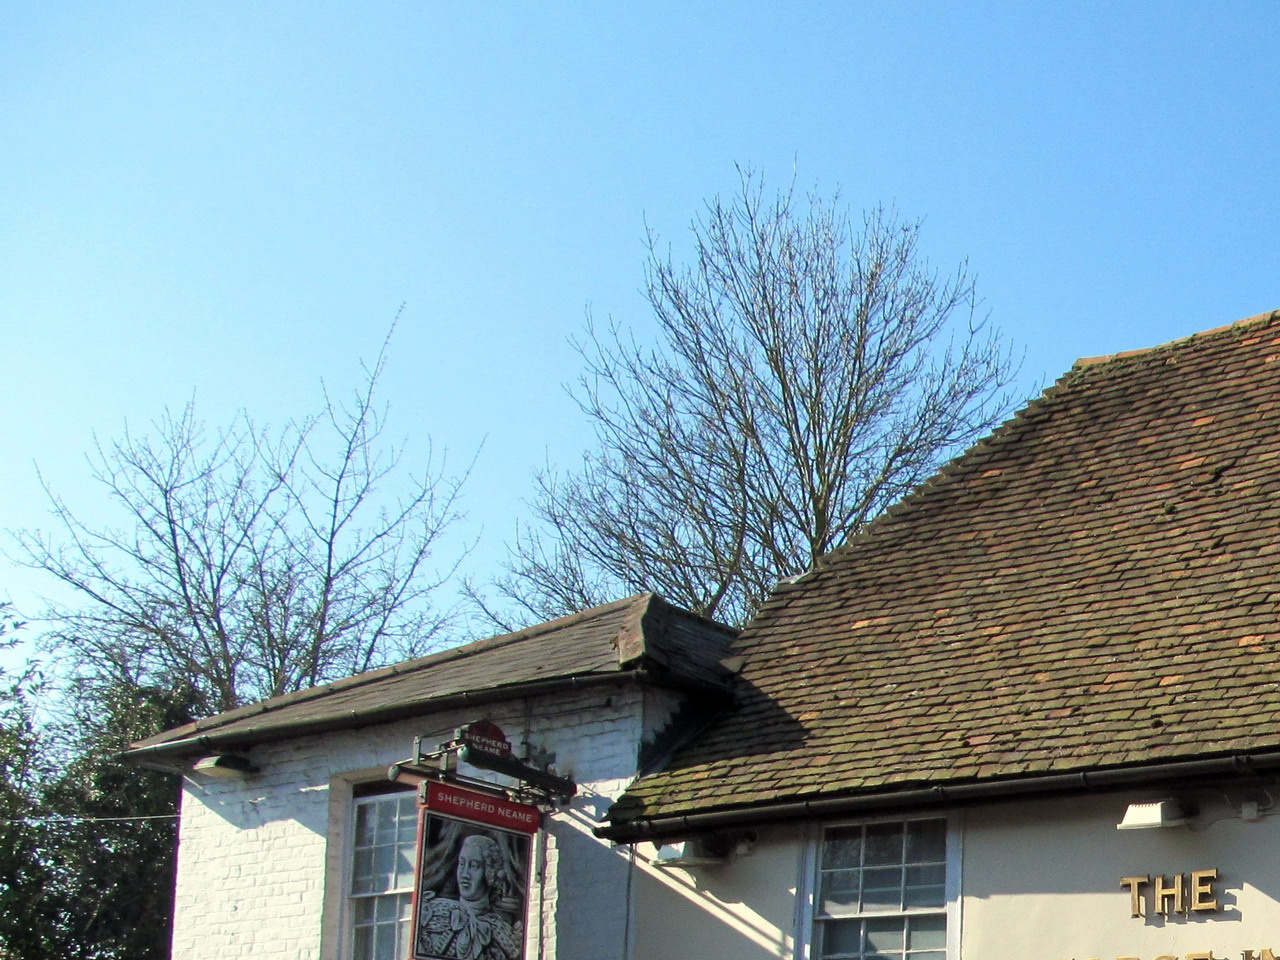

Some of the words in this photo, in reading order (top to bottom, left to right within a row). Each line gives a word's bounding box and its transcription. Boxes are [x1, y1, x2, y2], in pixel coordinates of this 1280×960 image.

[464, 732, 509, 751] SHEPHERD
[437, 792, 495, 814] SHEPHERD
[498, 807, 533, 823] NEAME
[1120, 868, 1218, 918] THE
